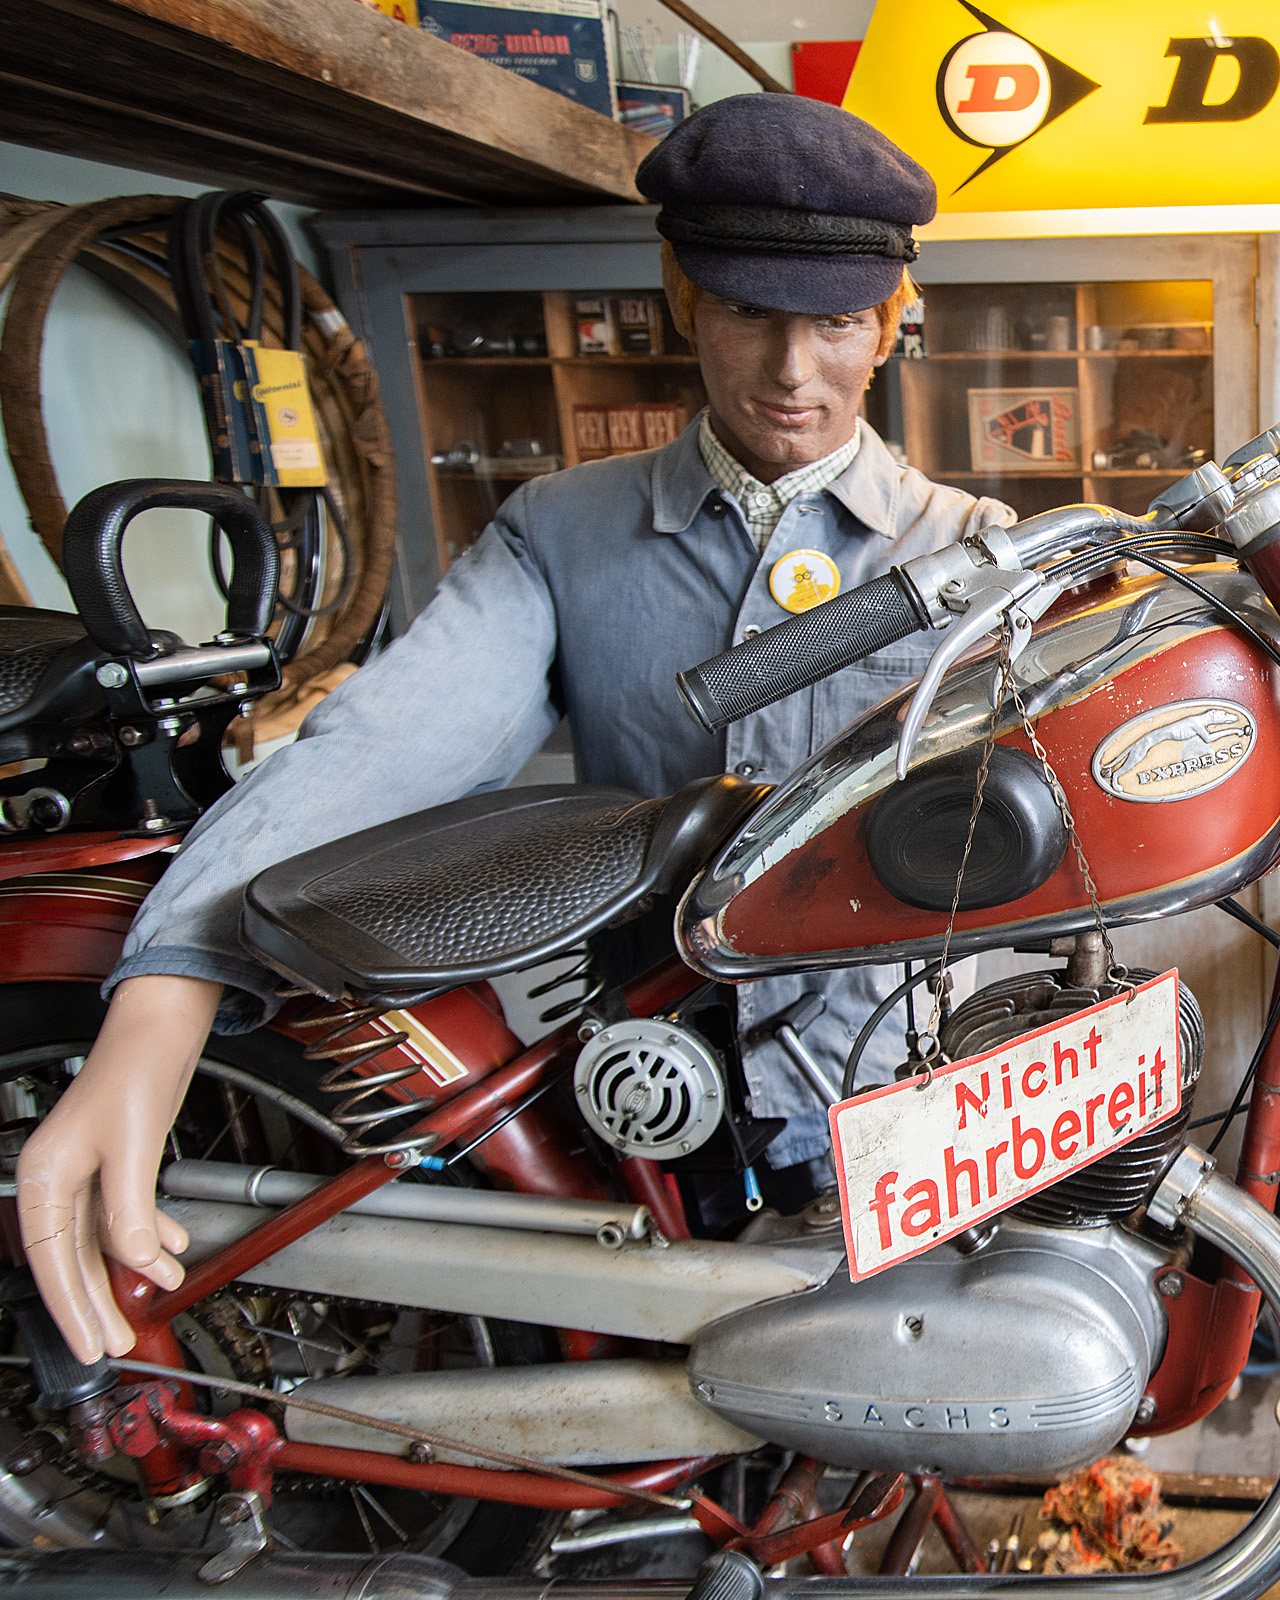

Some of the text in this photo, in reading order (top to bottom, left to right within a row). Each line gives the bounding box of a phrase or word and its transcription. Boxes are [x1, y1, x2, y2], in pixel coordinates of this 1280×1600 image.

[956, 63, 1041, 114] D
[608, 411, 642, 448] REX
[1137, 743, 1243, 785] EXPRESS
[955, 1026, 1102, 1131] Nicht
[869, 1046, 1166, 1251] fahrbereit
[824, 1400, 1010, 1430] SACHS
